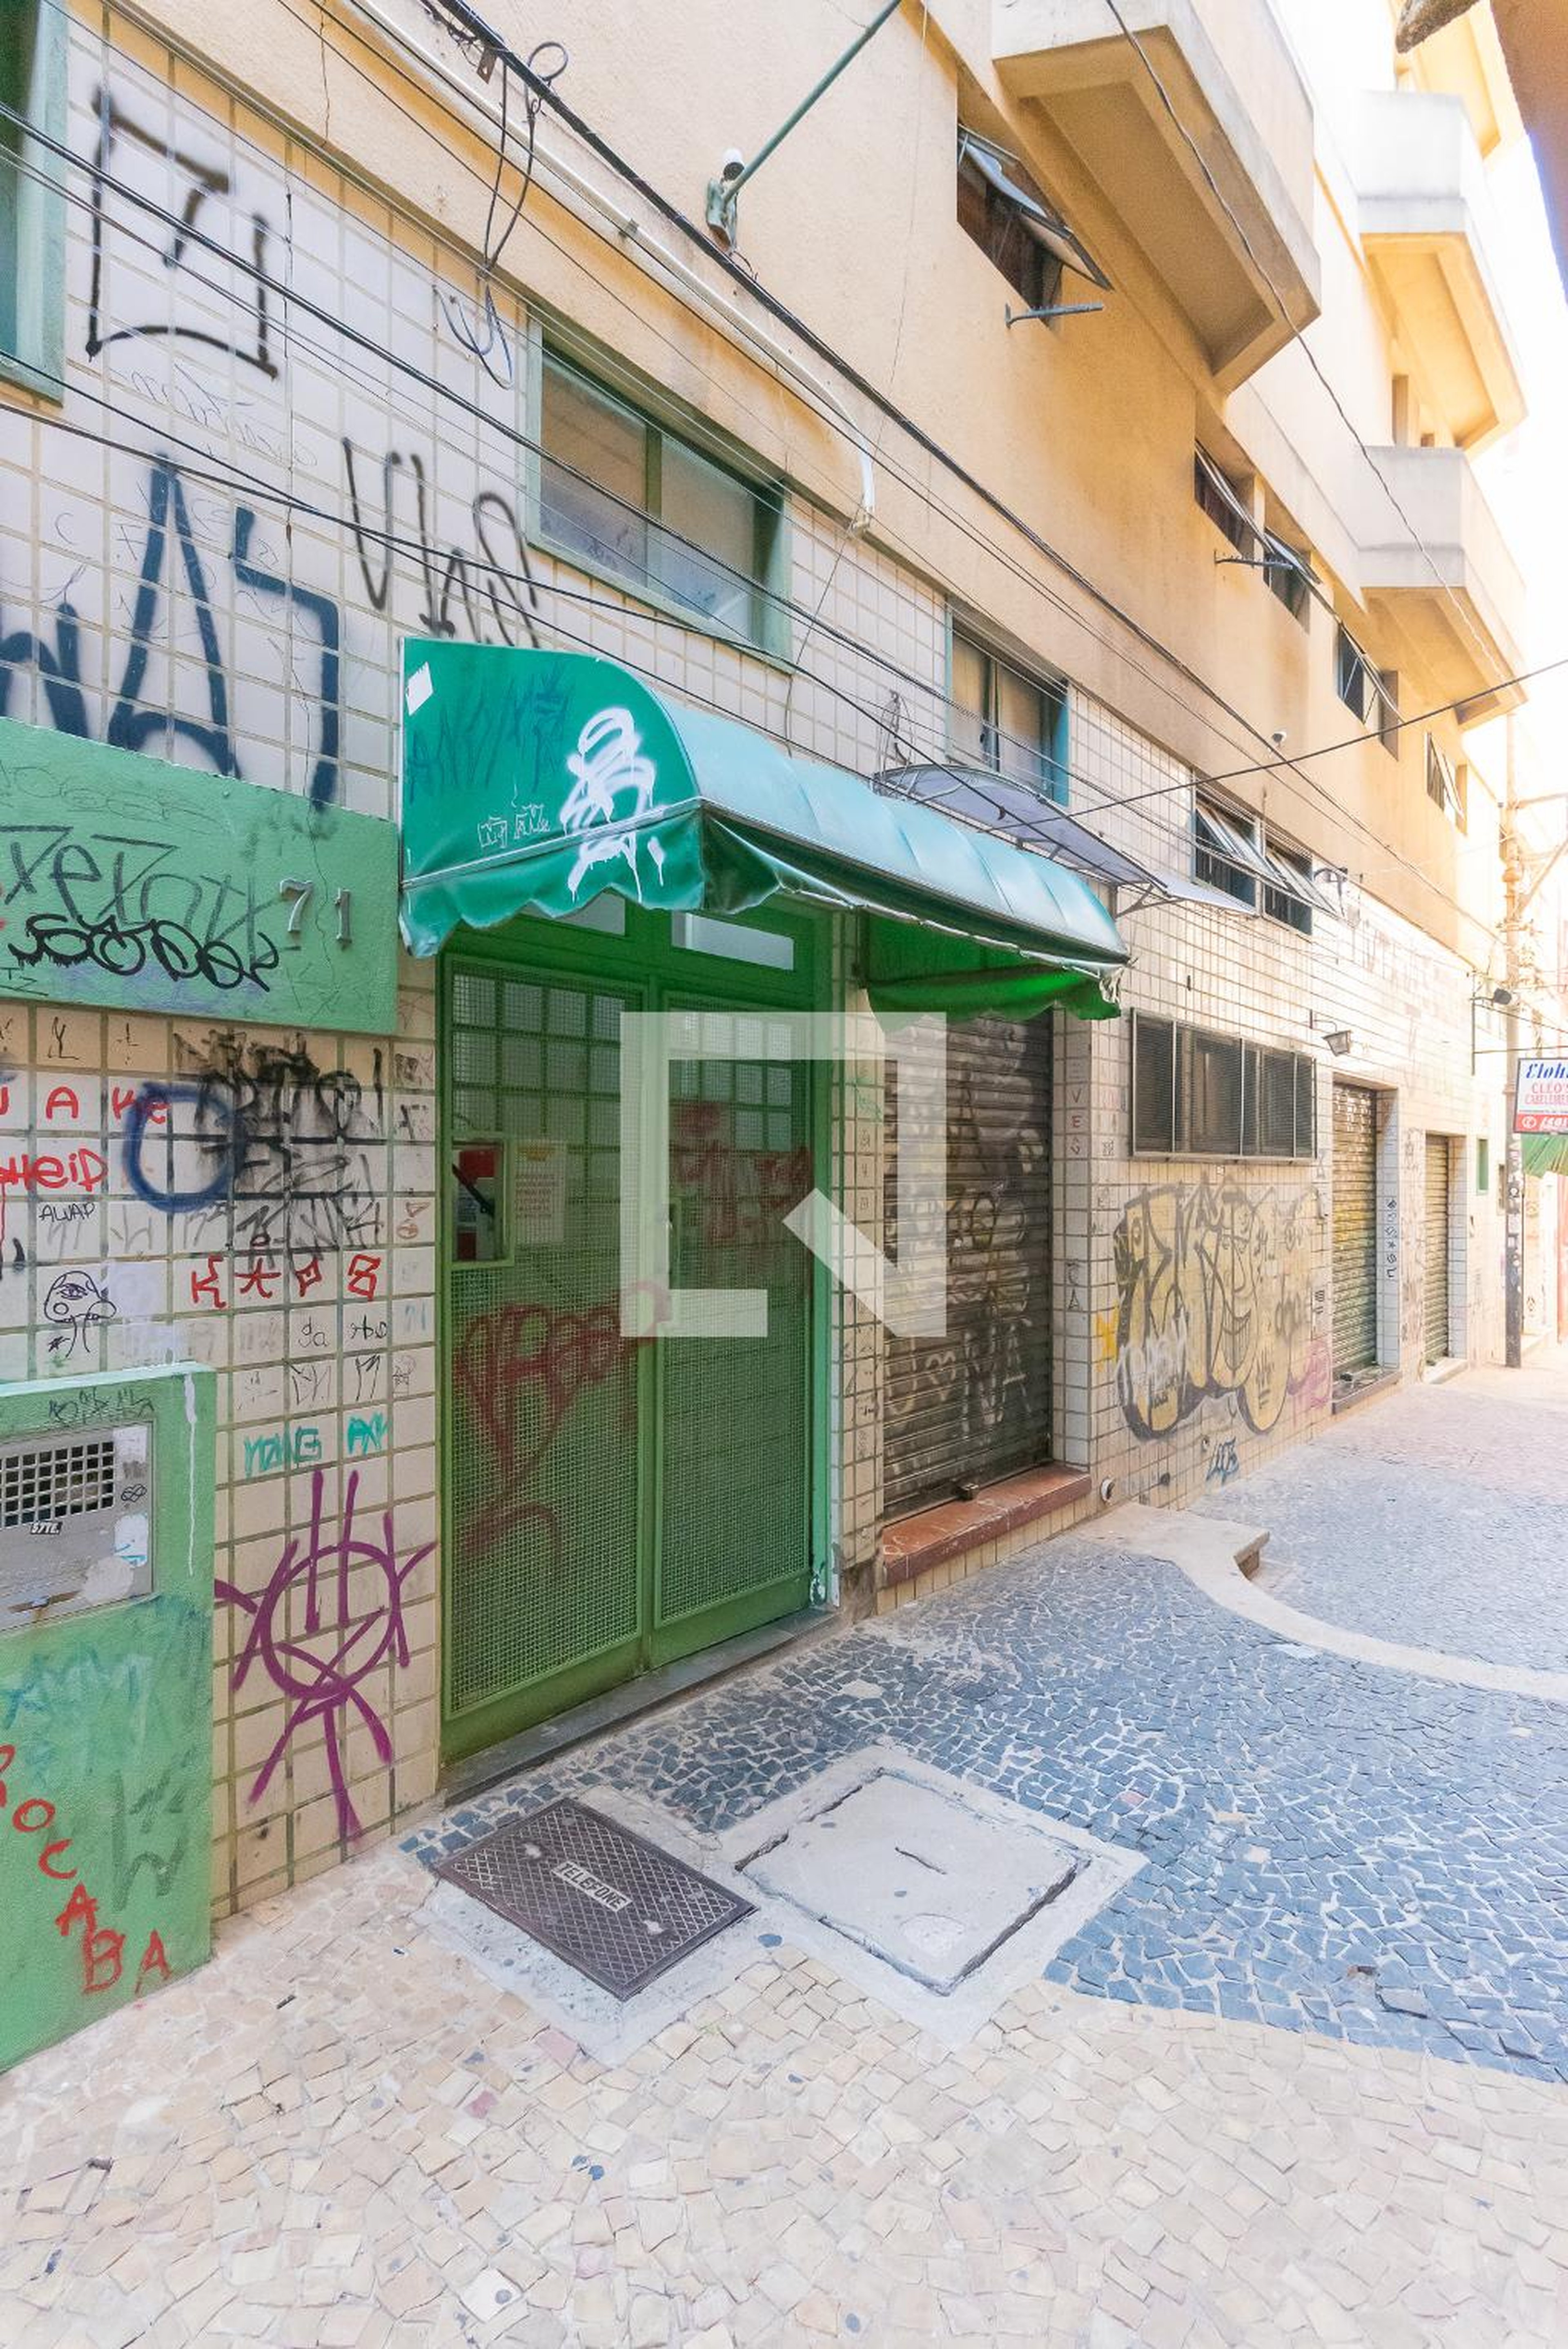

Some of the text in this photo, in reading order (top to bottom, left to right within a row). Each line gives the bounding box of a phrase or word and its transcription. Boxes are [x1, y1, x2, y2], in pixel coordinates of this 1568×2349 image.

[279, 877, 352, 944] 71
[1526, 1062, 1568, 1078] Eloh
[559, 1863, 628, 1910] TELEFONE
